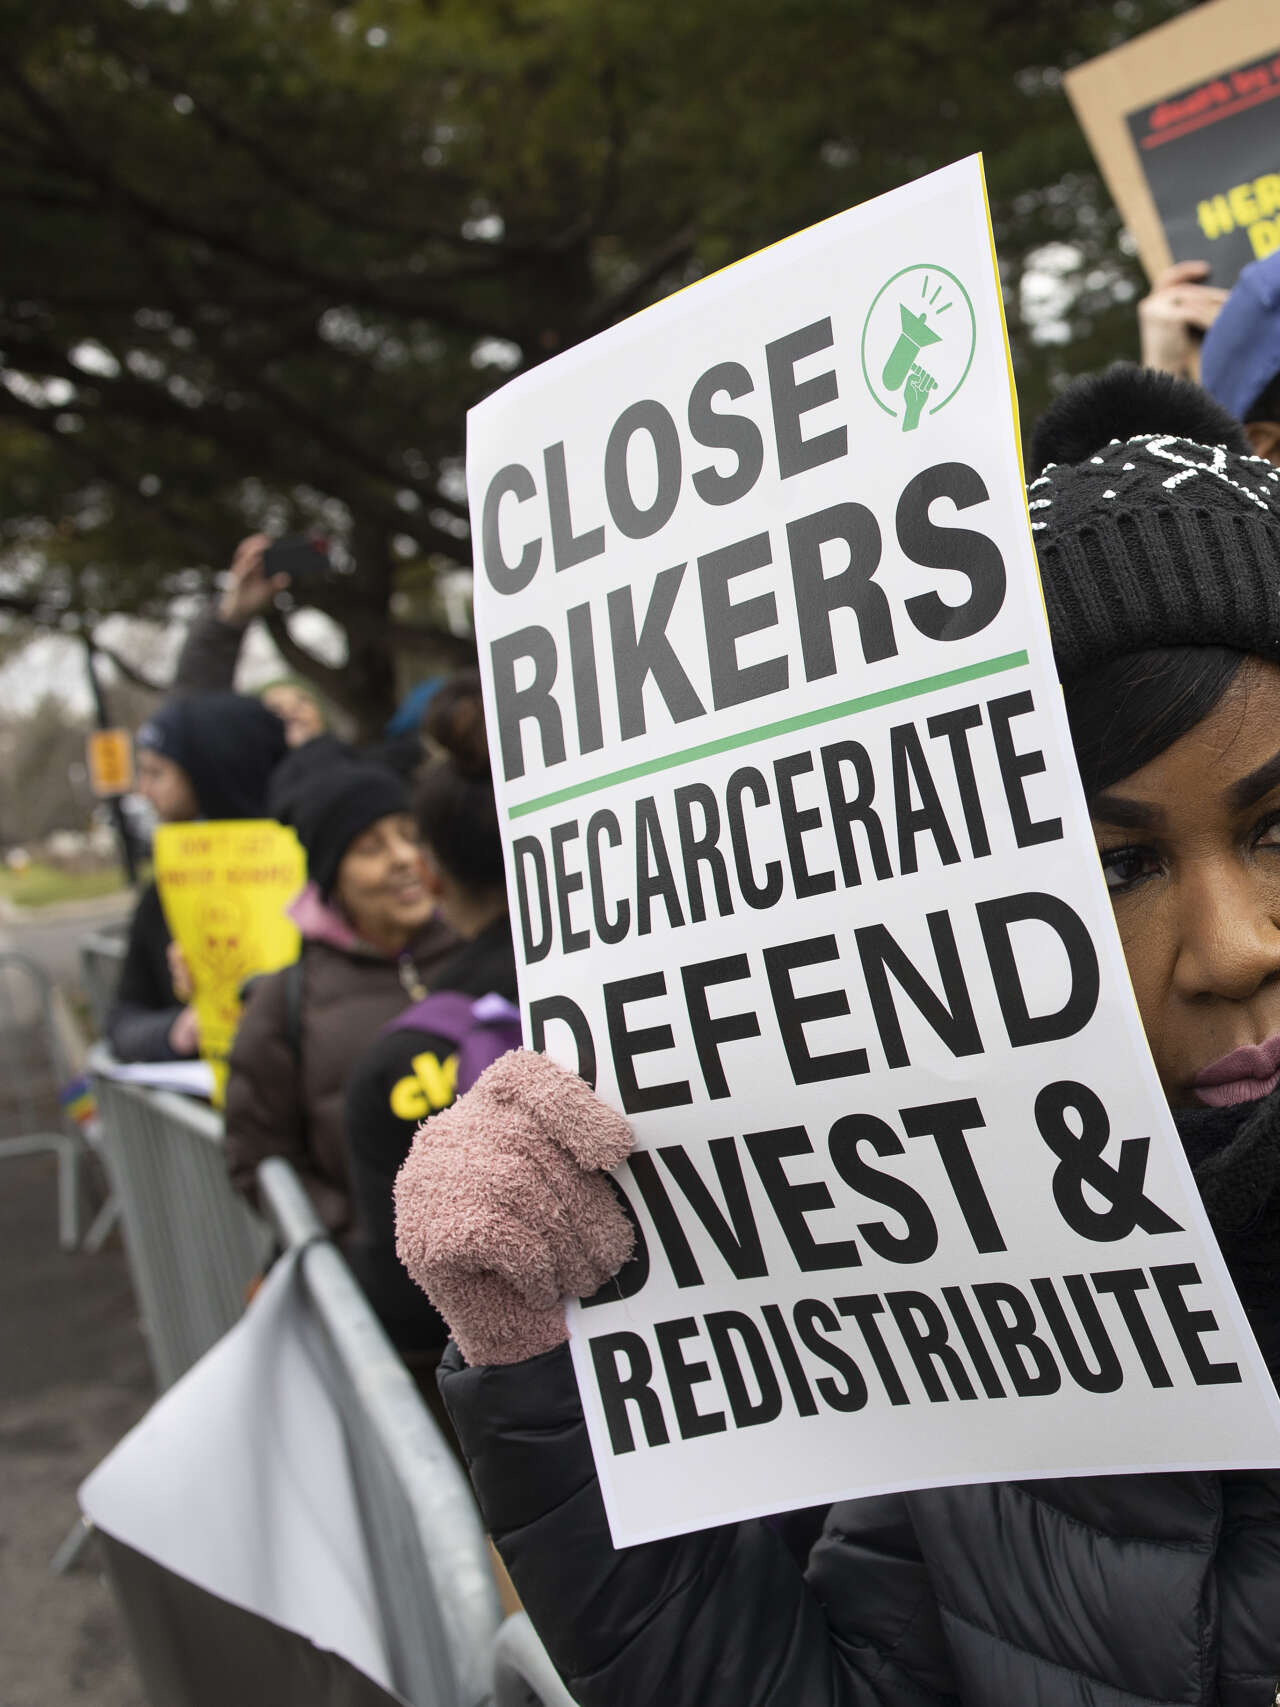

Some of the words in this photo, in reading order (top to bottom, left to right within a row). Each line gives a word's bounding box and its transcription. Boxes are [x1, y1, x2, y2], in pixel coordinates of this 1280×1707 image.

[482, 316, 848, 596] CLOSE
[490, 462, 1007, 782] RIKERS
[513, 689, 1064, 965] DECARCERATE
[529, 892, 1100, 1114] DEFEND
[1034, 1080, 1185, 1243] &
[588, 1263, 1242, 1455] REDISTRIBUTE
